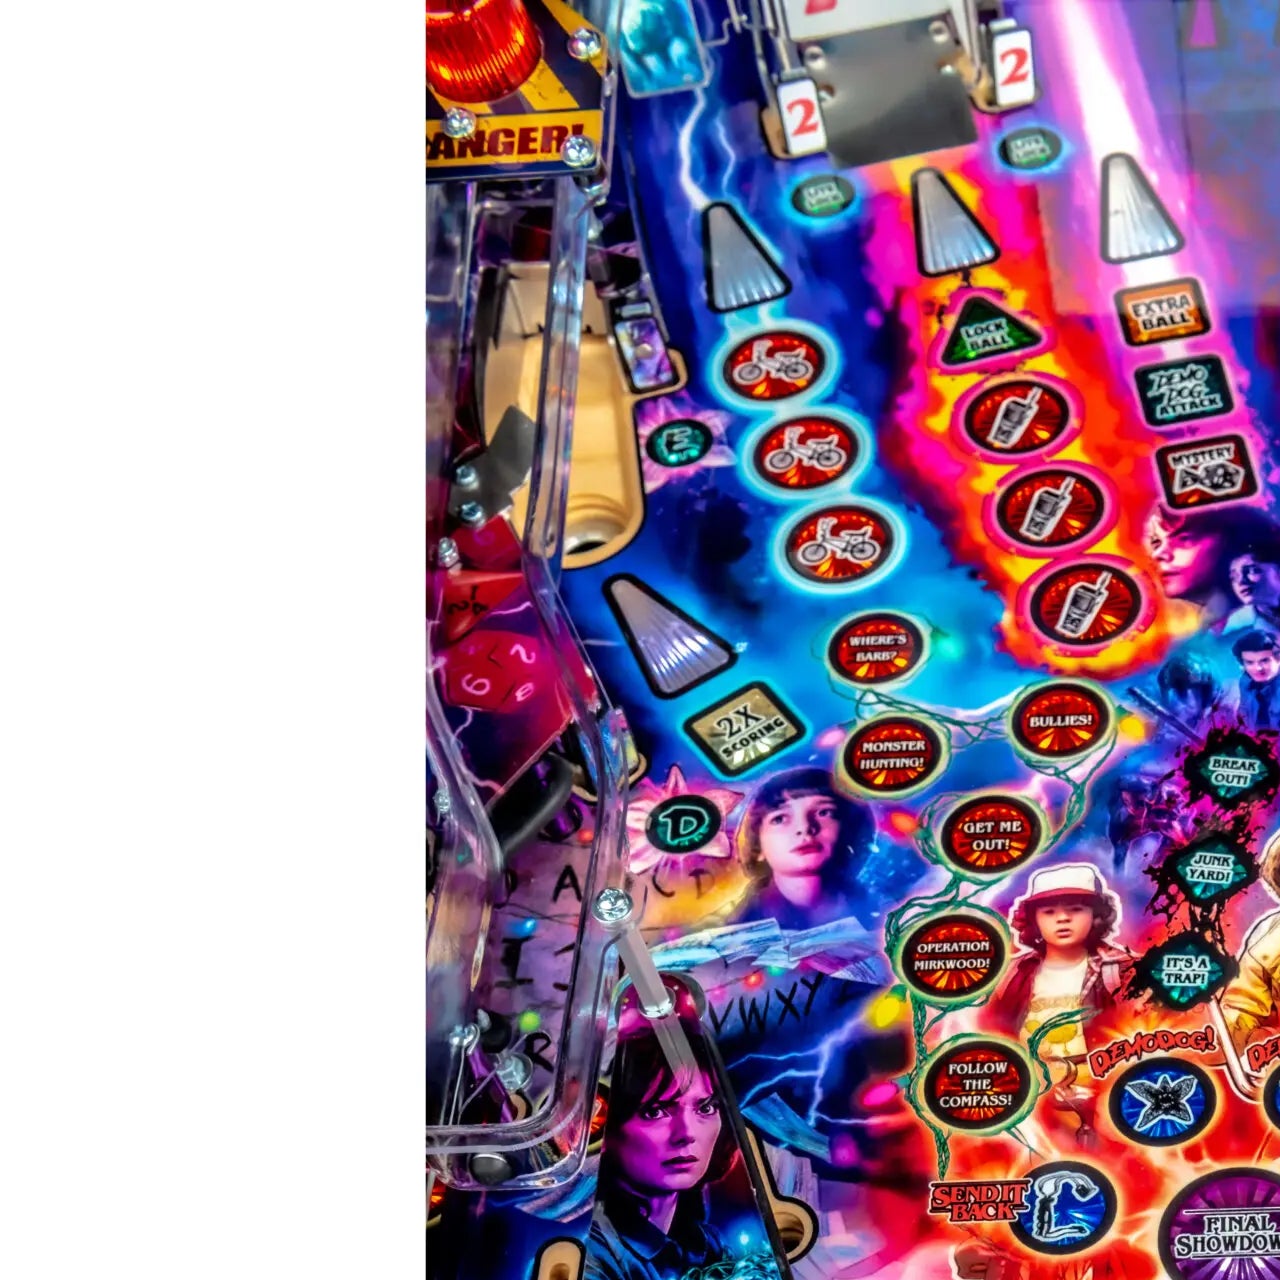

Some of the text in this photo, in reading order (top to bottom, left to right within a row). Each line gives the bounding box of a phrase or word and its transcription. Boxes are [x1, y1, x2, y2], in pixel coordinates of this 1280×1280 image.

[1000, 48, 1029, 86] 2
[787, 98, 819, 136] 2
[426, 124, 584, 159] ANGER!
[1132, 295, 1190, 315] EXTRA
[1142, 313, 1190, 331] BALL
[965, 322, 1005, 339] LOCK
[970, 335, 1009, 350] BALL
[1157, 397, 1221, 417] ATTACK
[1170, 445, 1234, 468] MYSTERY
[849, 634, 908, 648] WHERE'S
[855, 650, 898, 663] BARB?
[716, 703, 763, 740] 2X
[1029, 714, 1093, 728] BULLIES!
[721, 717, 786, 759] SCORING
[861, 740, 926, 753] MONSTER
[859, 756, 925, 771] HUNTING!
[1212, 758, 1258, 772] BREAK
[1214, 773, 1249, 786] OUT!
[963, 820, 1022, 834] GET ME
[972, 838, 1011, 851] OUT!
[1193, 853, 1232, 867] JUNK
[1188, 868, 1231, 882] YARD!
[916, 941, 990, 954] OPERATION
[913, 958, 991, 971] MIRKWOOD!
[1165, 957, 1209, 969] IT'S A
[1164, 971, 1206, 984] TRAP!
[1090, 1026, 1216, 1078] DEMODOG!
[948, 1062, 1008, 1075] FOLLOW
[963, 1079, 992, 1091] THE
[939, 1094, 1013, 1109] COMPASS!
[931, 1182, 1029, 1208] SEND IT
[950, 1202, 1016, 1222] BACK
[1205, 1215, 1275, 1235] FINAL
